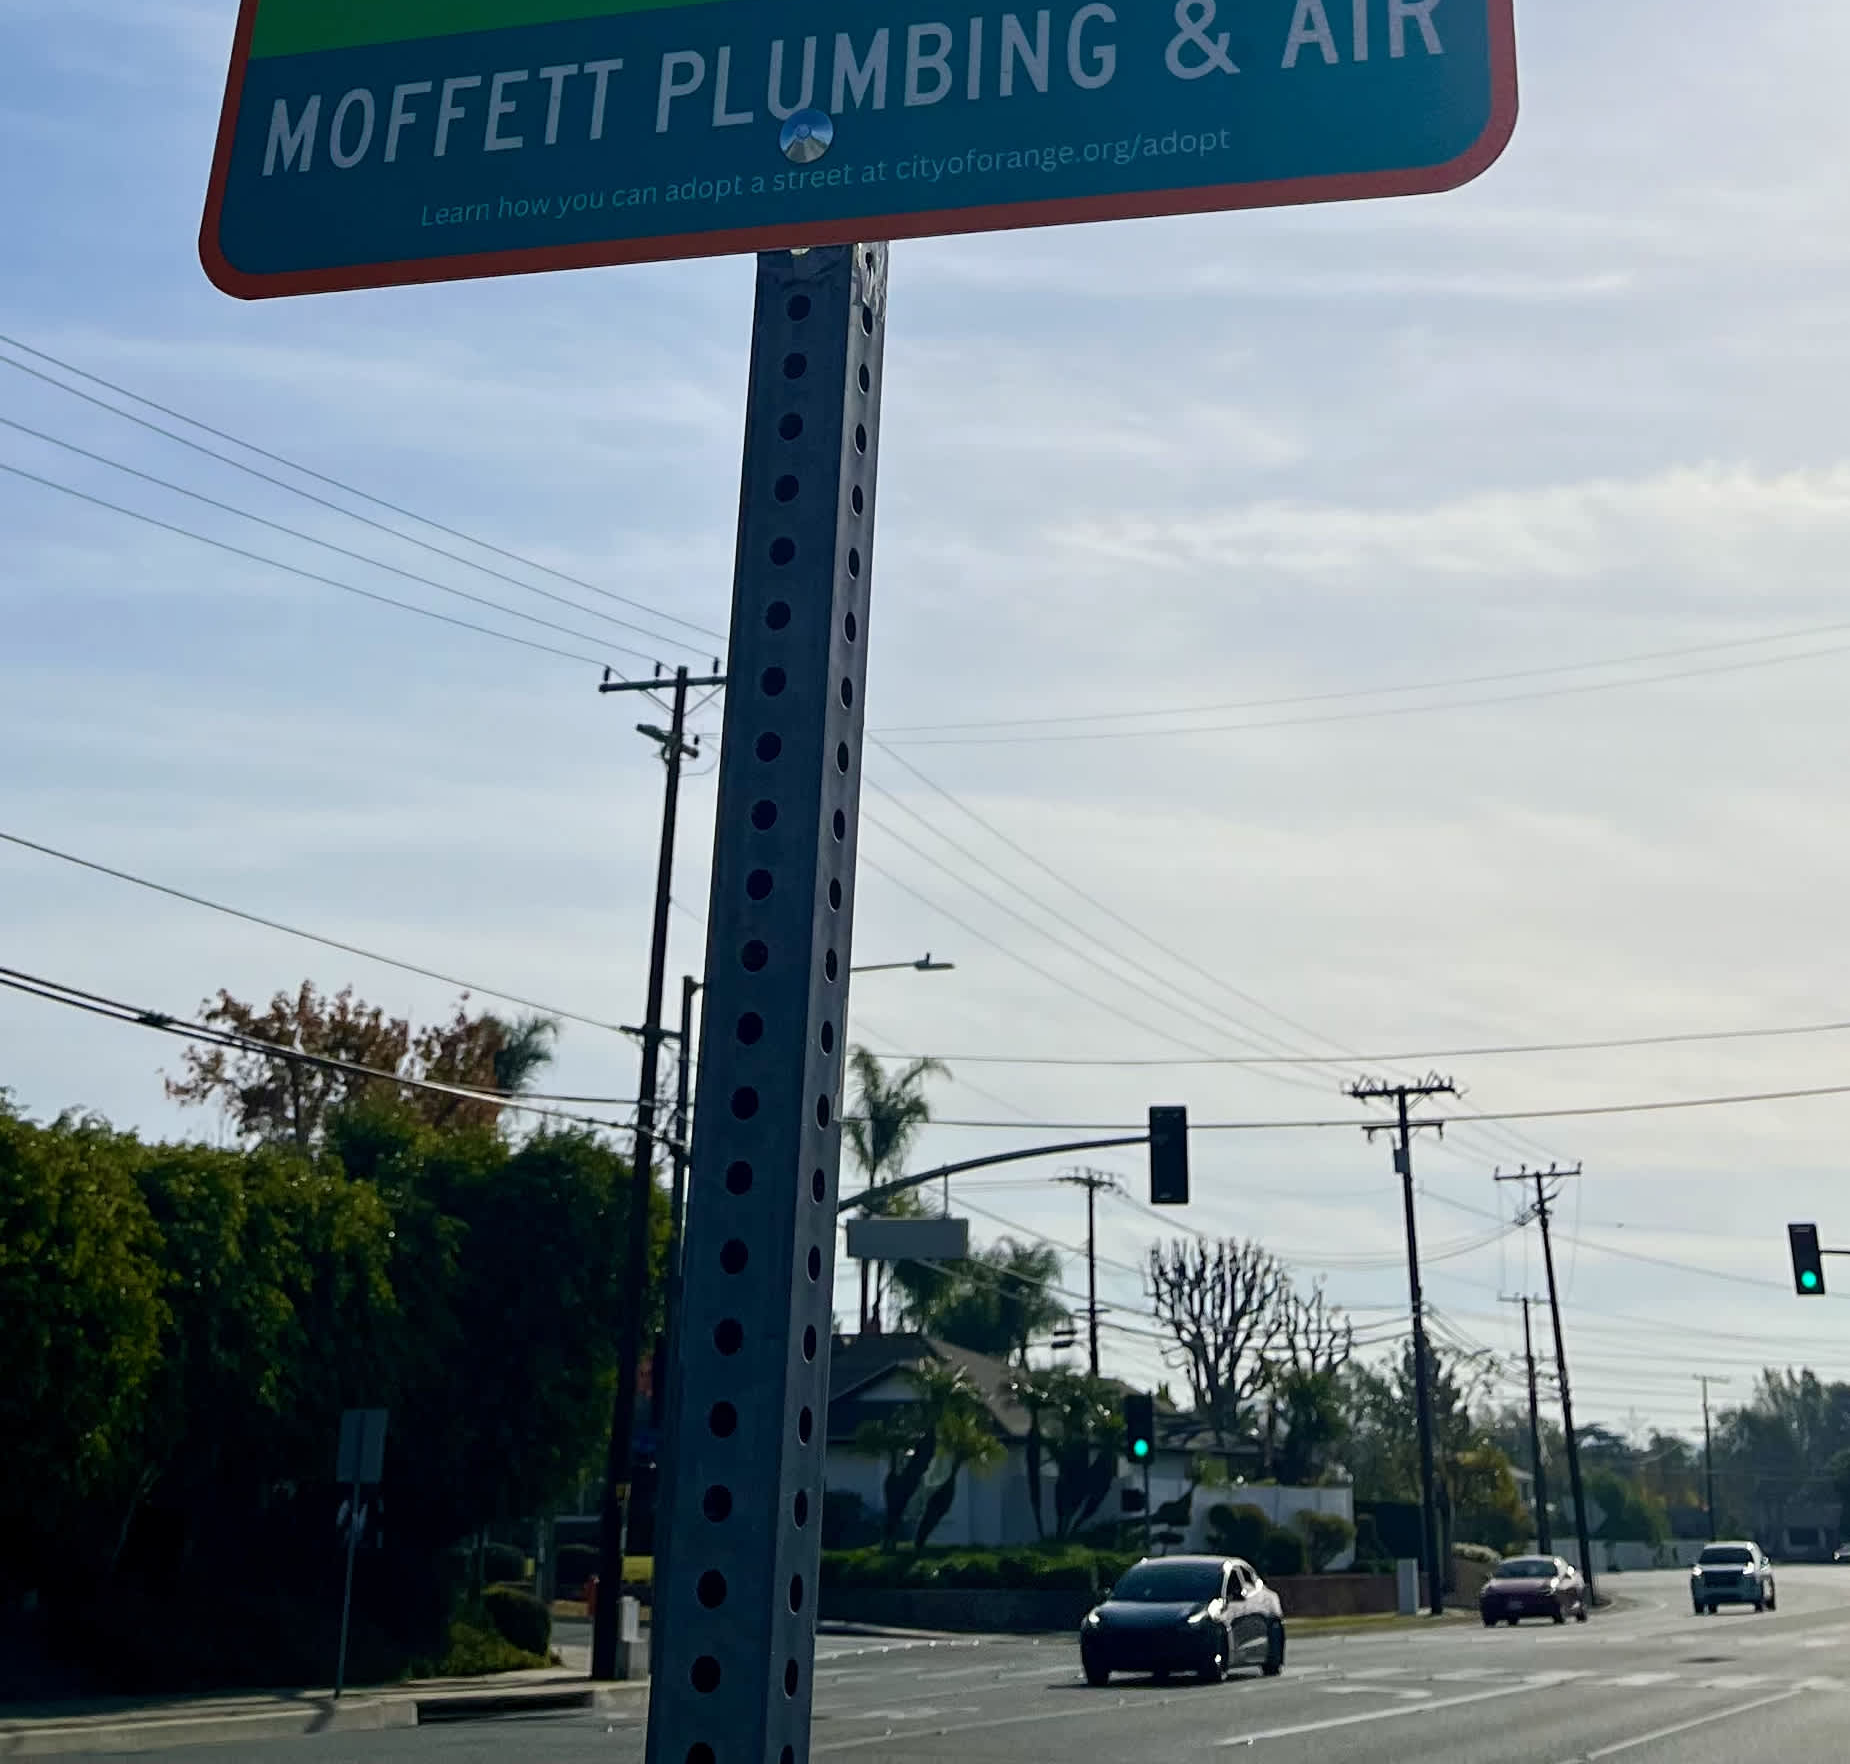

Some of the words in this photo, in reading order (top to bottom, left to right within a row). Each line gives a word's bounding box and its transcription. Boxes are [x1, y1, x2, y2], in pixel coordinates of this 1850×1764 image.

[261, 58, 623, 176] MOFFETT
[655, 2, 1117, 134] PLUMBING
[420, 204, 490, 227] Learn
[498, 195, 552, 220] how
[555, 193, 604, 219] you
[612, 185, 657, 207] can
[665, 173, 743, 203] adopt
[751, 180, 765, 196] a
[773, 162, 852, 193] street
[861, 158, 887, 184] at
[895, 126, 1231, 183] cityoforange.org/adopt
